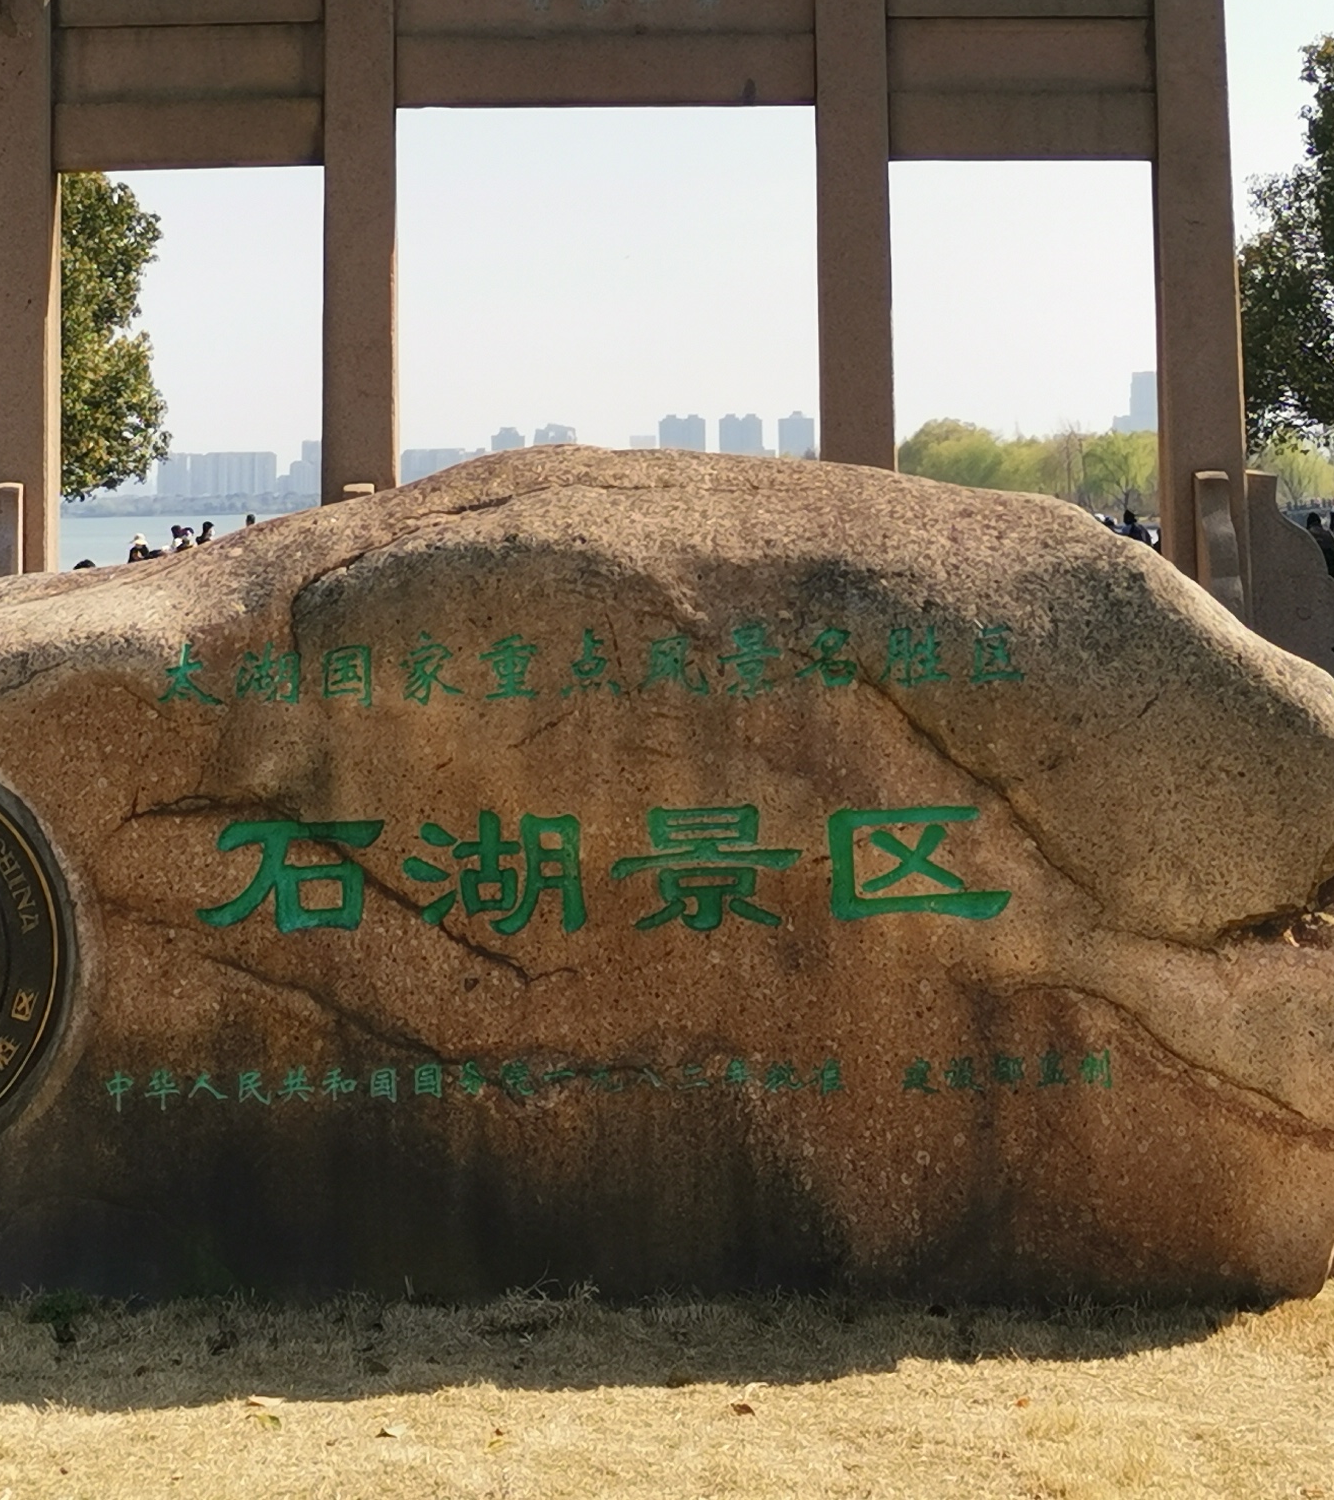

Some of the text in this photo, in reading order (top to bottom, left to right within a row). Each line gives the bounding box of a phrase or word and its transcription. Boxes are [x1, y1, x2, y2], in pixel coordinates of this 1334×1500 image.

[157, 625, 1028, 707] 太湖国家重点风景名胜区
[197, 803, 1013, 935] 石湖景区
